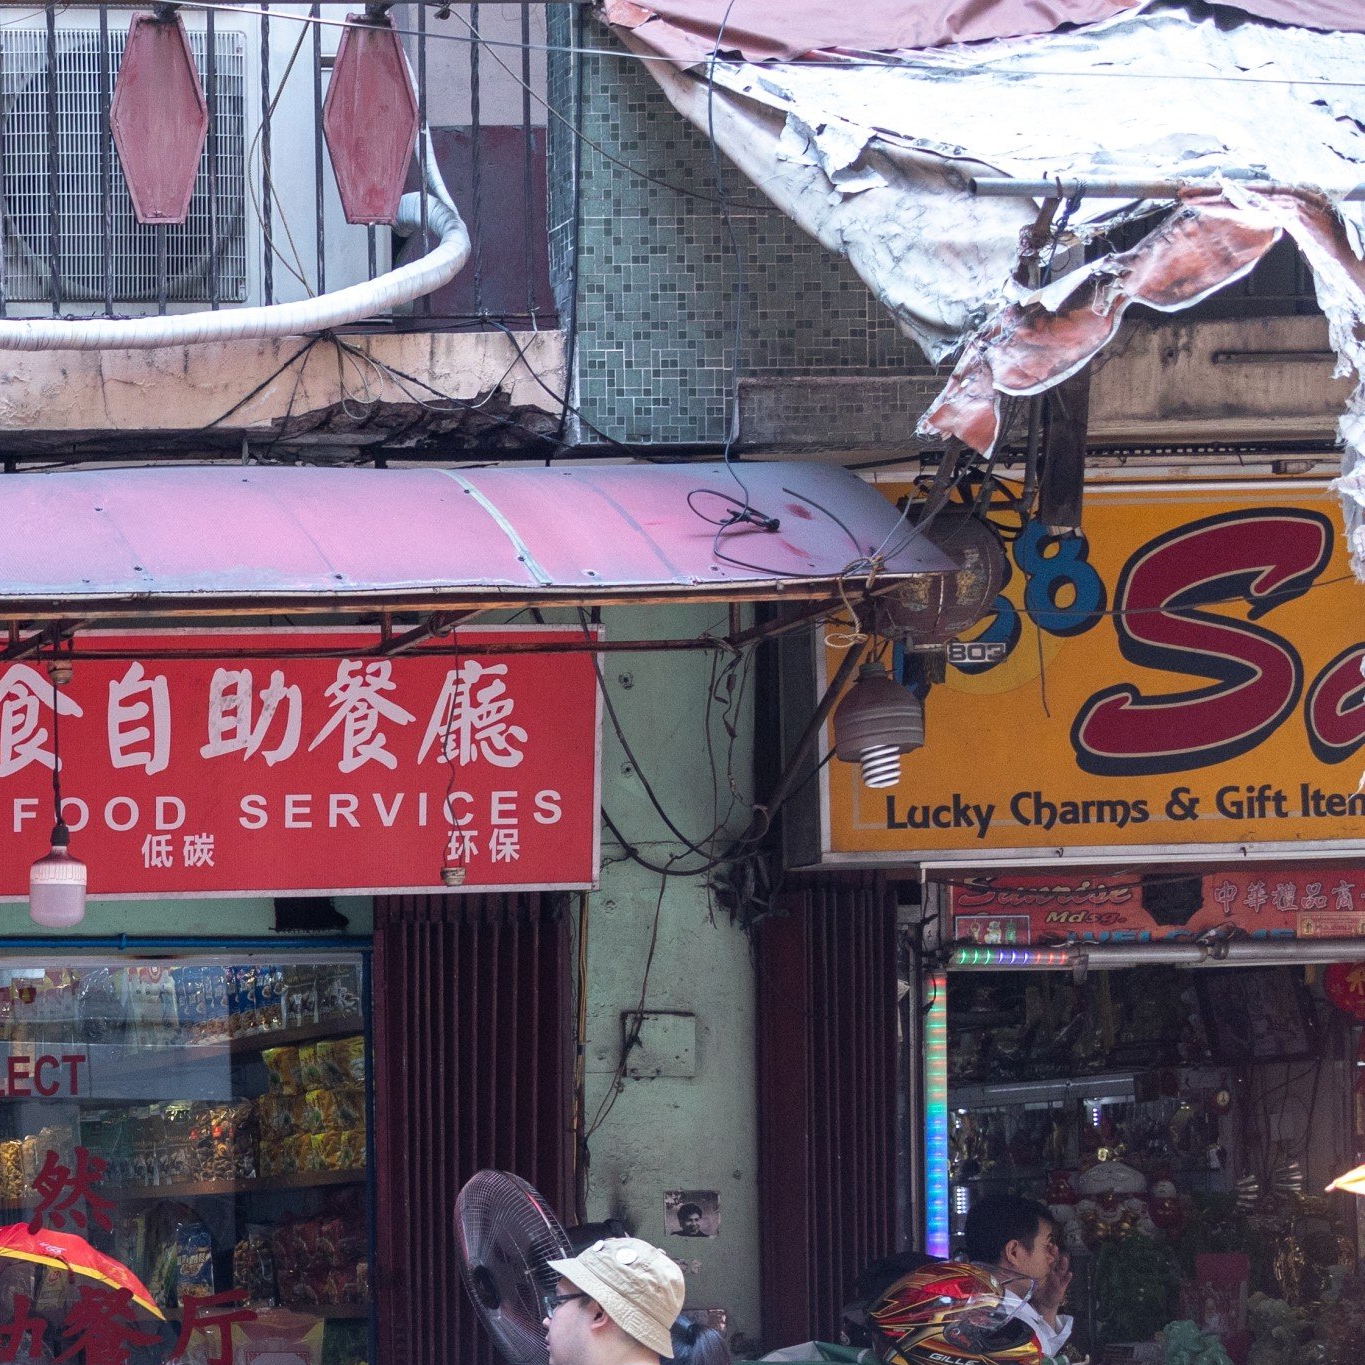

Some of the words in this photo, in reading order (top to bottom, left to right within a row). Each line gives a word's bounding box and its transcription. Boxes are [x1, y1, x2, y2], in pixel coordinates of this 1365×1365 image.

[948, 642, 1006, 663] 803
[13, 796, 187, 833] FOOD
[239, 789, 563, 830] SERVICES
[886, 794, 996, 838] Lucky
[1011, 792, 1149, 829] Charms
[1165, 788, 1199, 821] &
[1216, 783, 1288, 820] Gift
[141, 833, 216, 869] 低碳
[447, 828, 521, 863] 环保
